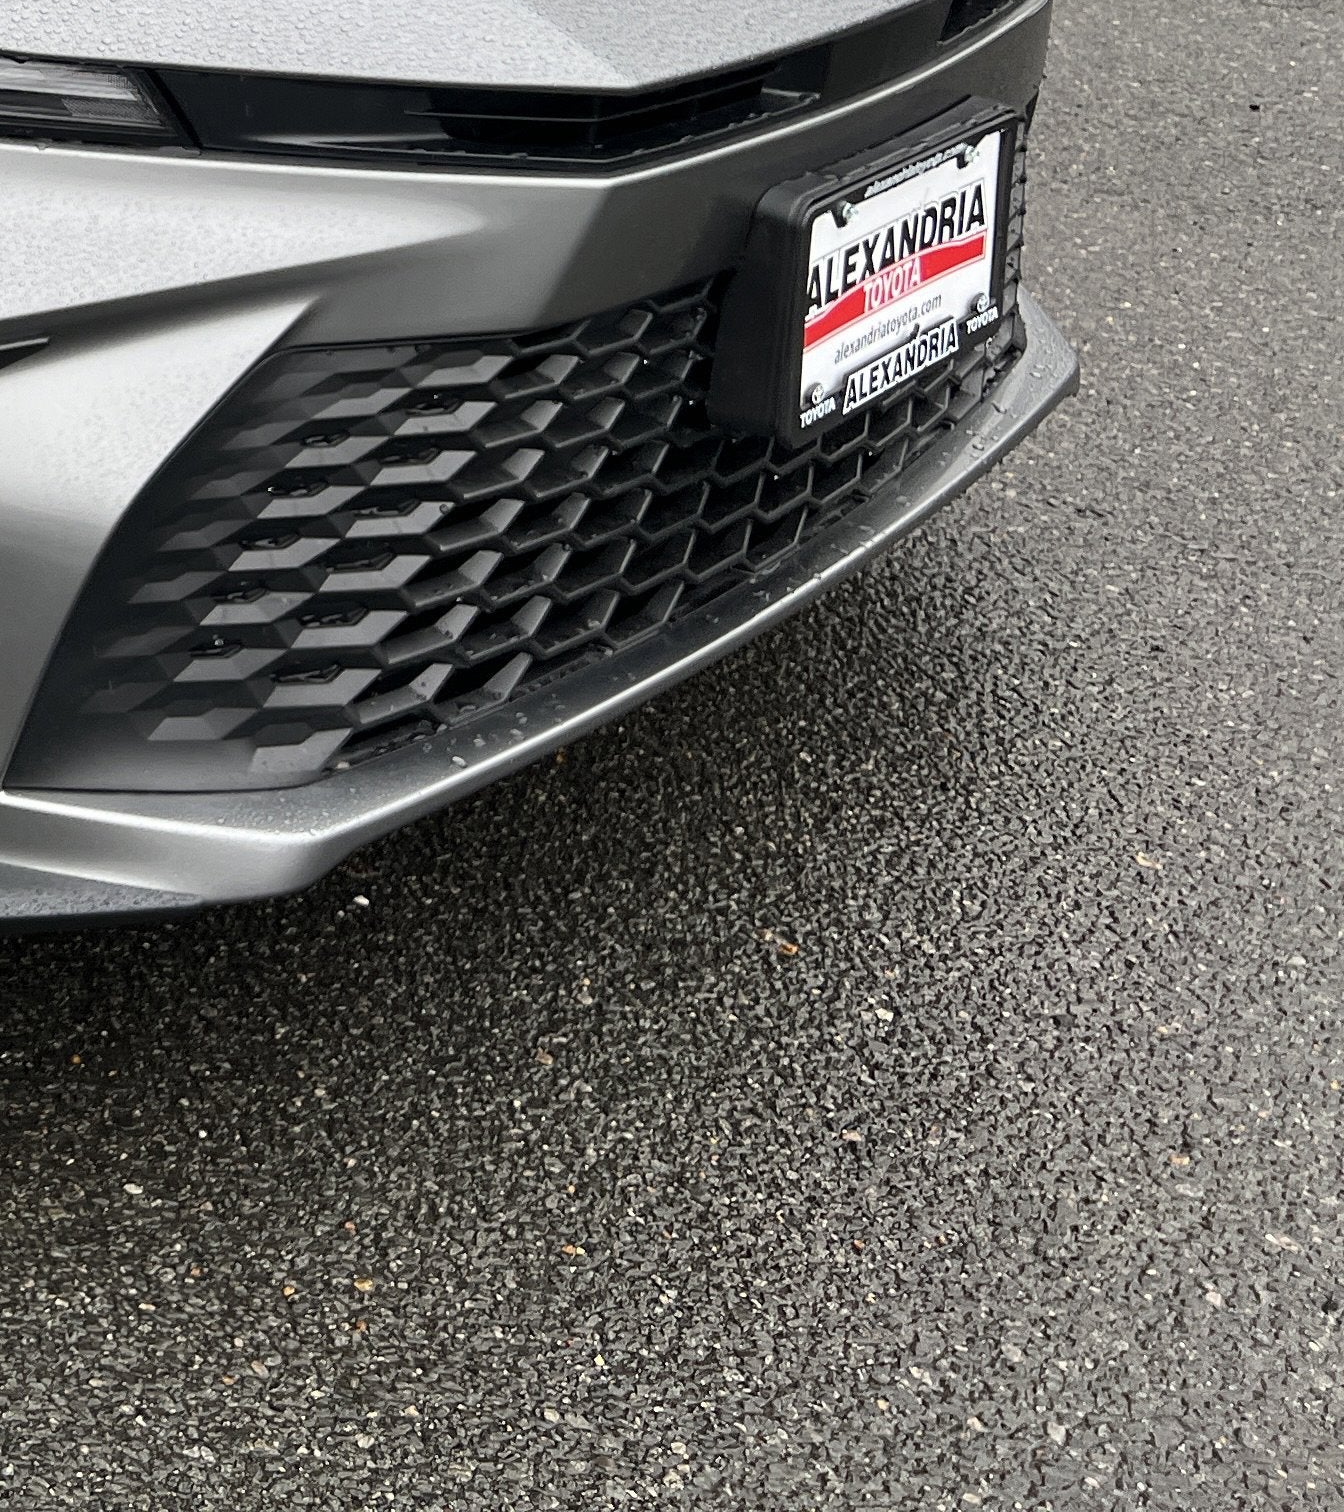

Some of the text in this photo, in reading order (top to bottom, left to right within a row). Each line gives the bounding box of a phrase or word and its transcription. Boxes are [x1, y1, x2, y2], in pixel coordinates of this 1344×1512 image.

[810, 184, 985, 311] ALEXANDRIA
[863, 258, 921, 312] TOYOTA
[834, 293, 942, 365] alexandriatoyota.com
[966, 306, 999, 334] TOYOTA
[845, 320, 957, 409] ALEXANDRIA
[800, 397, 836, 428] TOYOTA
